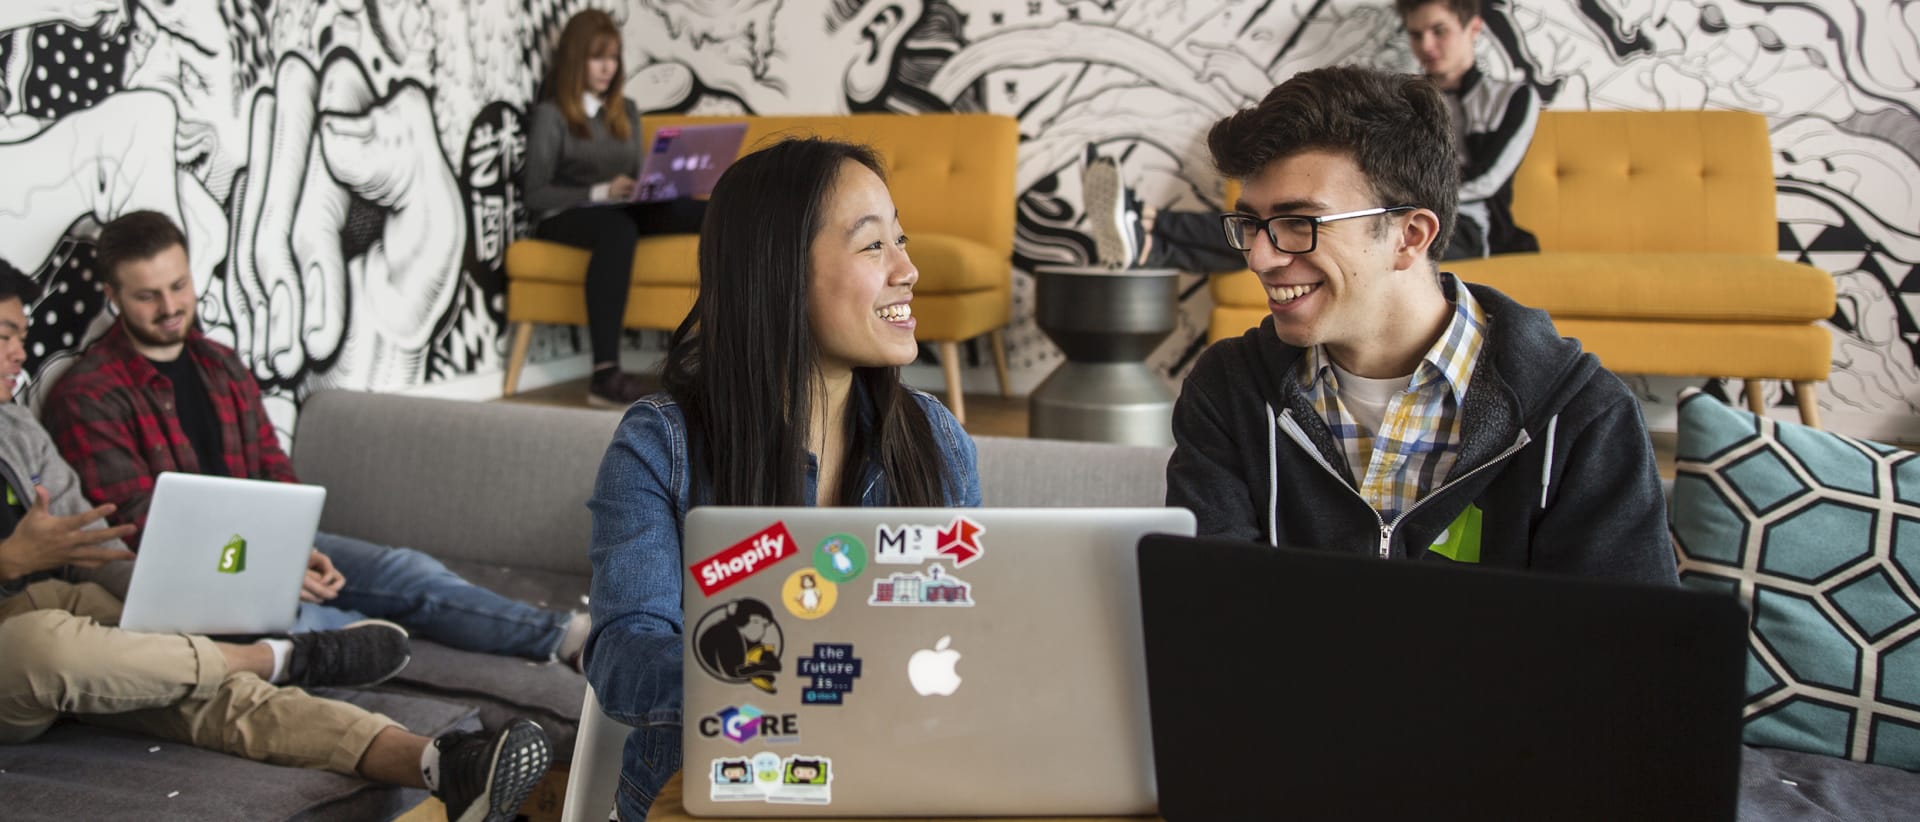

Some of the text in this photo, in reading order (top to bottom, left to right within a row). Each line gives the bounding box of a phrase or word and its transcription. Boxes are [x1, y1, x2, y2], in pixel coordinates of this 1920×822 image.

[222, 547, 236, 569] S
[701, 533, 784, 587] Shopify
[819, 646, 844, 659] the
[803, 660, 854, 674] future
[699, 706, 798, 741] CORE
